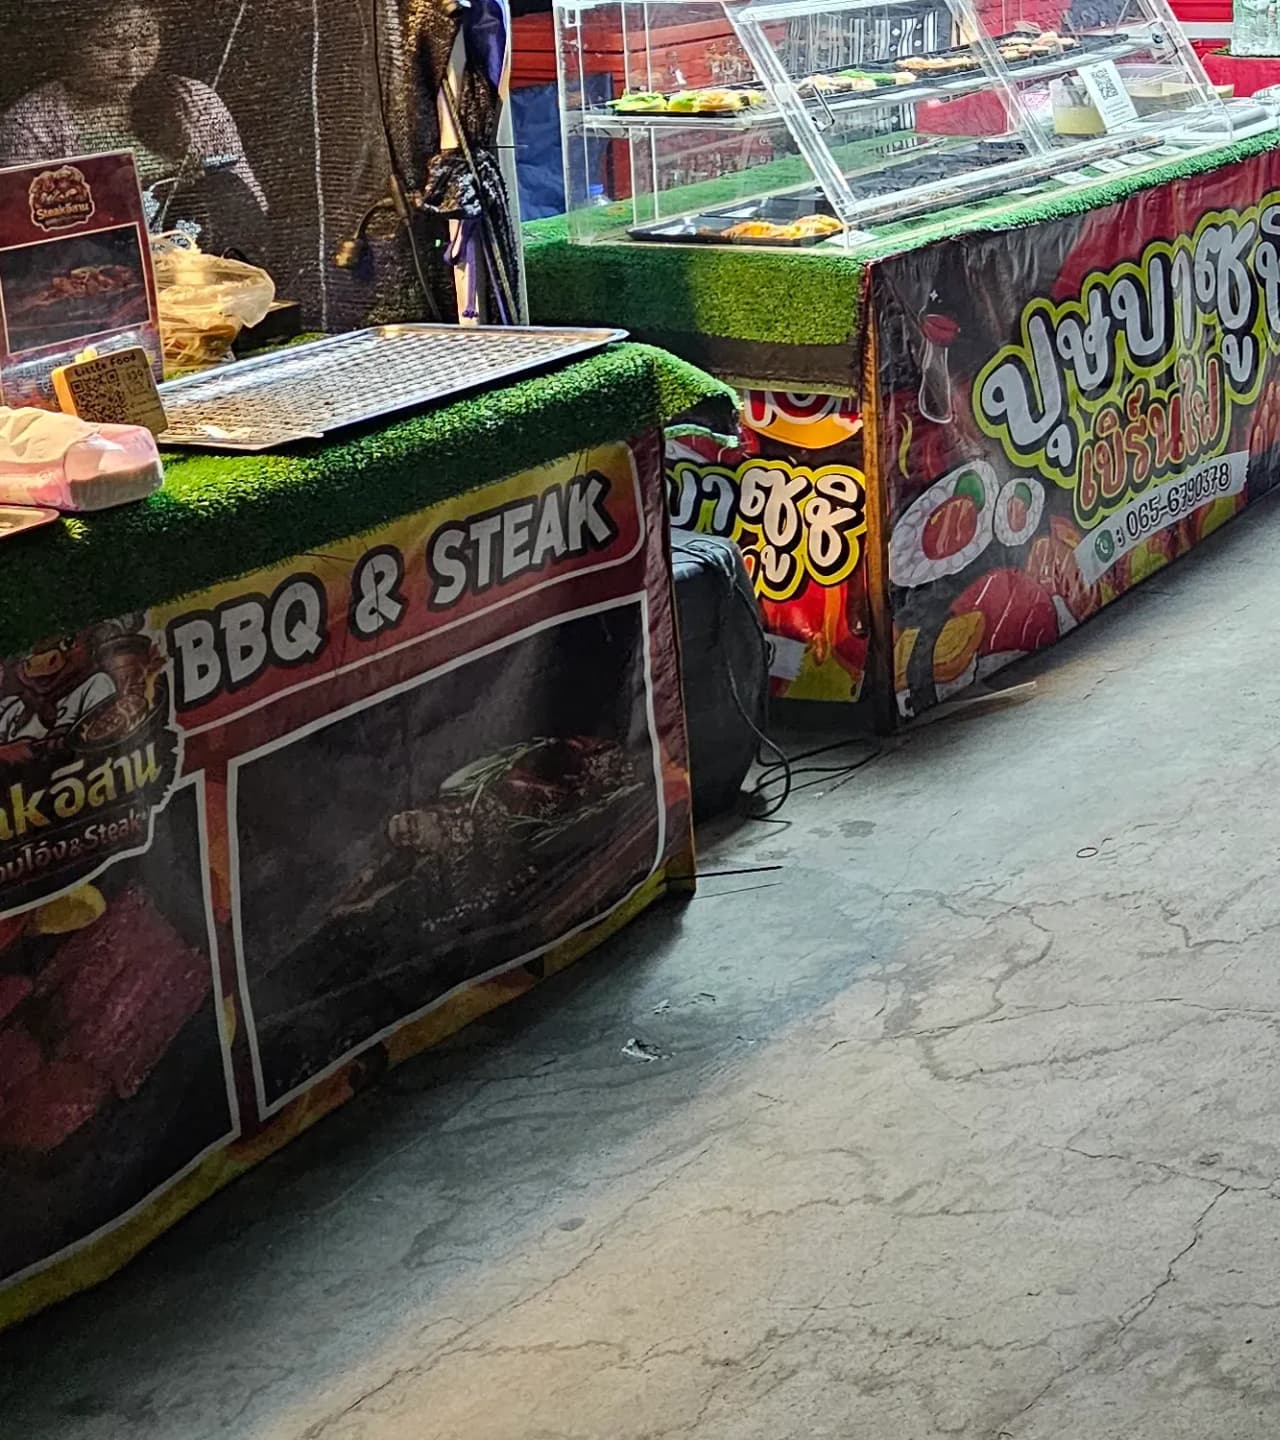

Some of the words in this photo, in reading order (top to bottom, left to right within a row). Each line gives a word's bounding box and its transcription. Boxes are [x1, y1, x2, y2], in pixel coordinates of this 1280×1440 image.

[1125, 462, 1231, 538] 065-6790378
[173, 580, 323, 705] BBQ
[354, 553, 402, 635] &
[431, 478, 614, 605] STEAK
